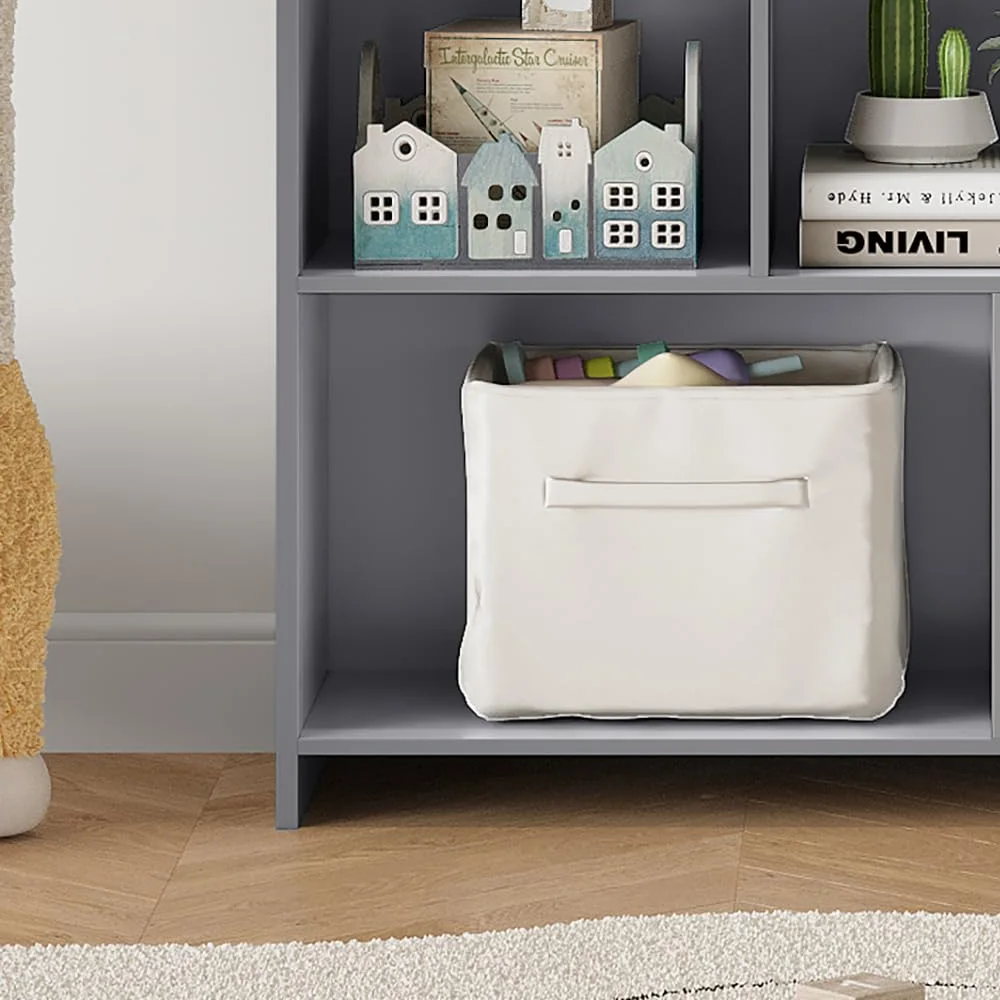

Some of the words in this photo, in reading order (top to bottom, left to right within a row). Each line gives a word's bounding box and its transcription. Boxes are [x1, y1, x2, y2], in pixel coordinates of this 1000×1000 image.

[438, 46, 511, 73] Intergalactic
[512, 46, 540, 66] Star
[543, 47, 589, 67] Cruiser
[826, 189, 872, 205] Hyde
[881, 192, 911, 204] Mr.
[920, 192, 932, 204] &
[836, 230, 969, 255] LIVING
